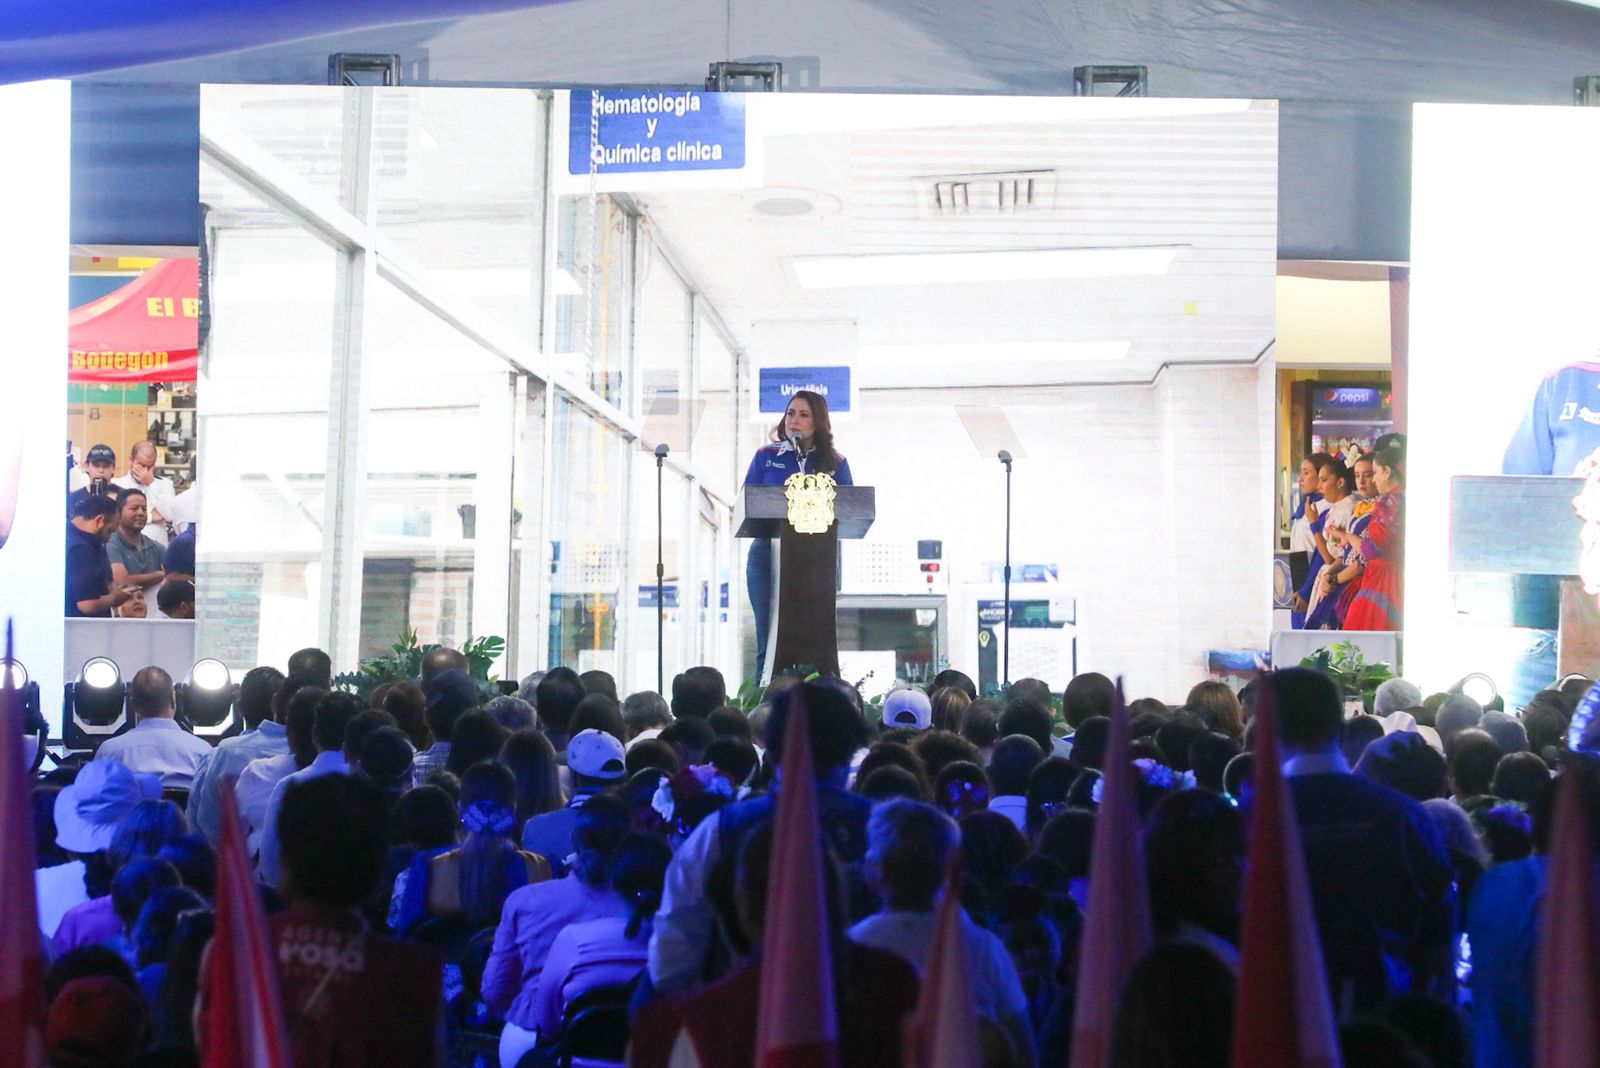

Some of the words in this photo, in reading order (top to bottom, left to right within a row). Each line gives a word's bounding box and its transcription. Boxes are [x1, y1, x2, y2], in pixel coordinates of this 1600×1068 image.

[593, 92, 700, 117] Hematología
[646, 118, 657, 138] y
[592, 143, 661, 165] Química
[667, 141, 723, 161] clínica
[146, 297, 175, 317] El
[1340, 392, 1369, 404] pepsi
